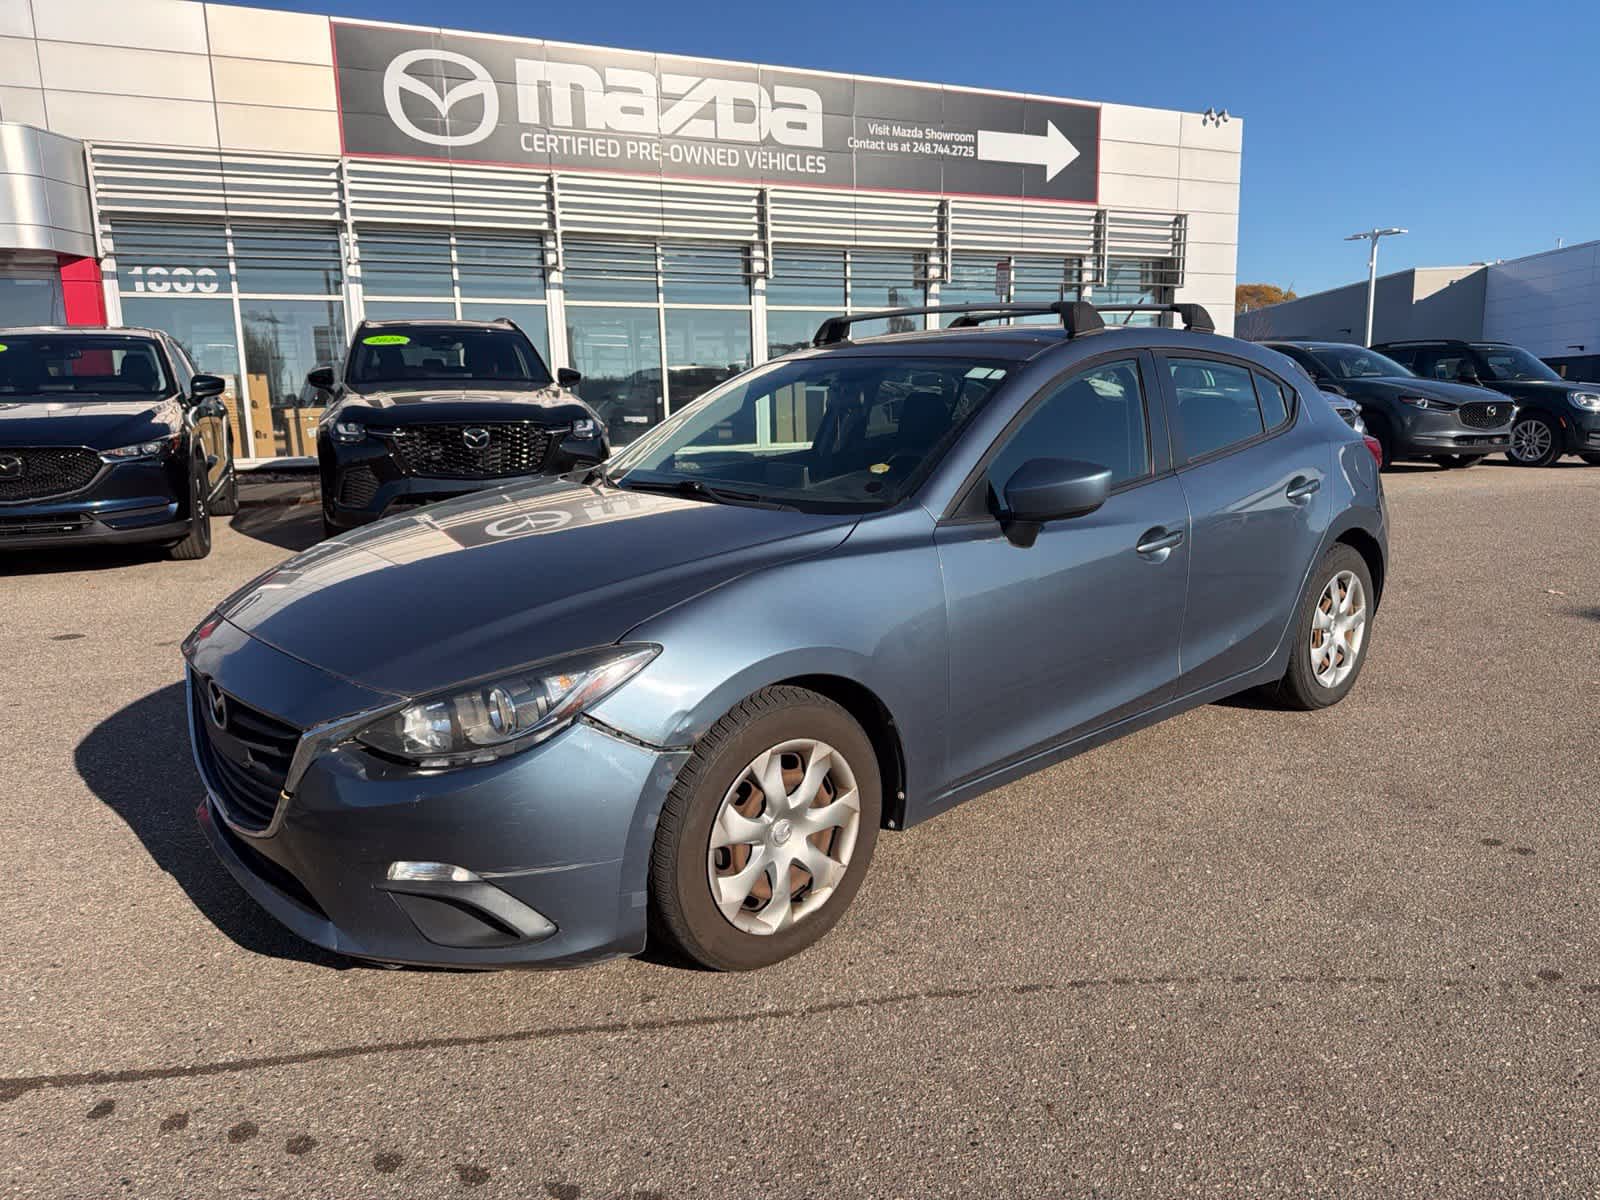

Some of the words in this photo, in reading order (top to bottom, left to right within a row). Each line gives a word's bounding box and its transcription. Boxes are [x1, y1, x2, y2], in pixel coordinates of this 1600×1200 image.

[867, 123, 890, 136] Visit
[892, 125, 923, 139] Mazda
[925, 128, 975, 143] Showroom
[520, 132, 620, 159] CERTIFIED
[626, 140, 740, 167] PRE-OWNED
[744, 149, 827, 174] VEHICLES
[847, 137, 886, 151] Contact
[887, 142, 899, 152] us
[900, 142, 911, 153] at
[913, 142, 975, 158] 248.744.2725
